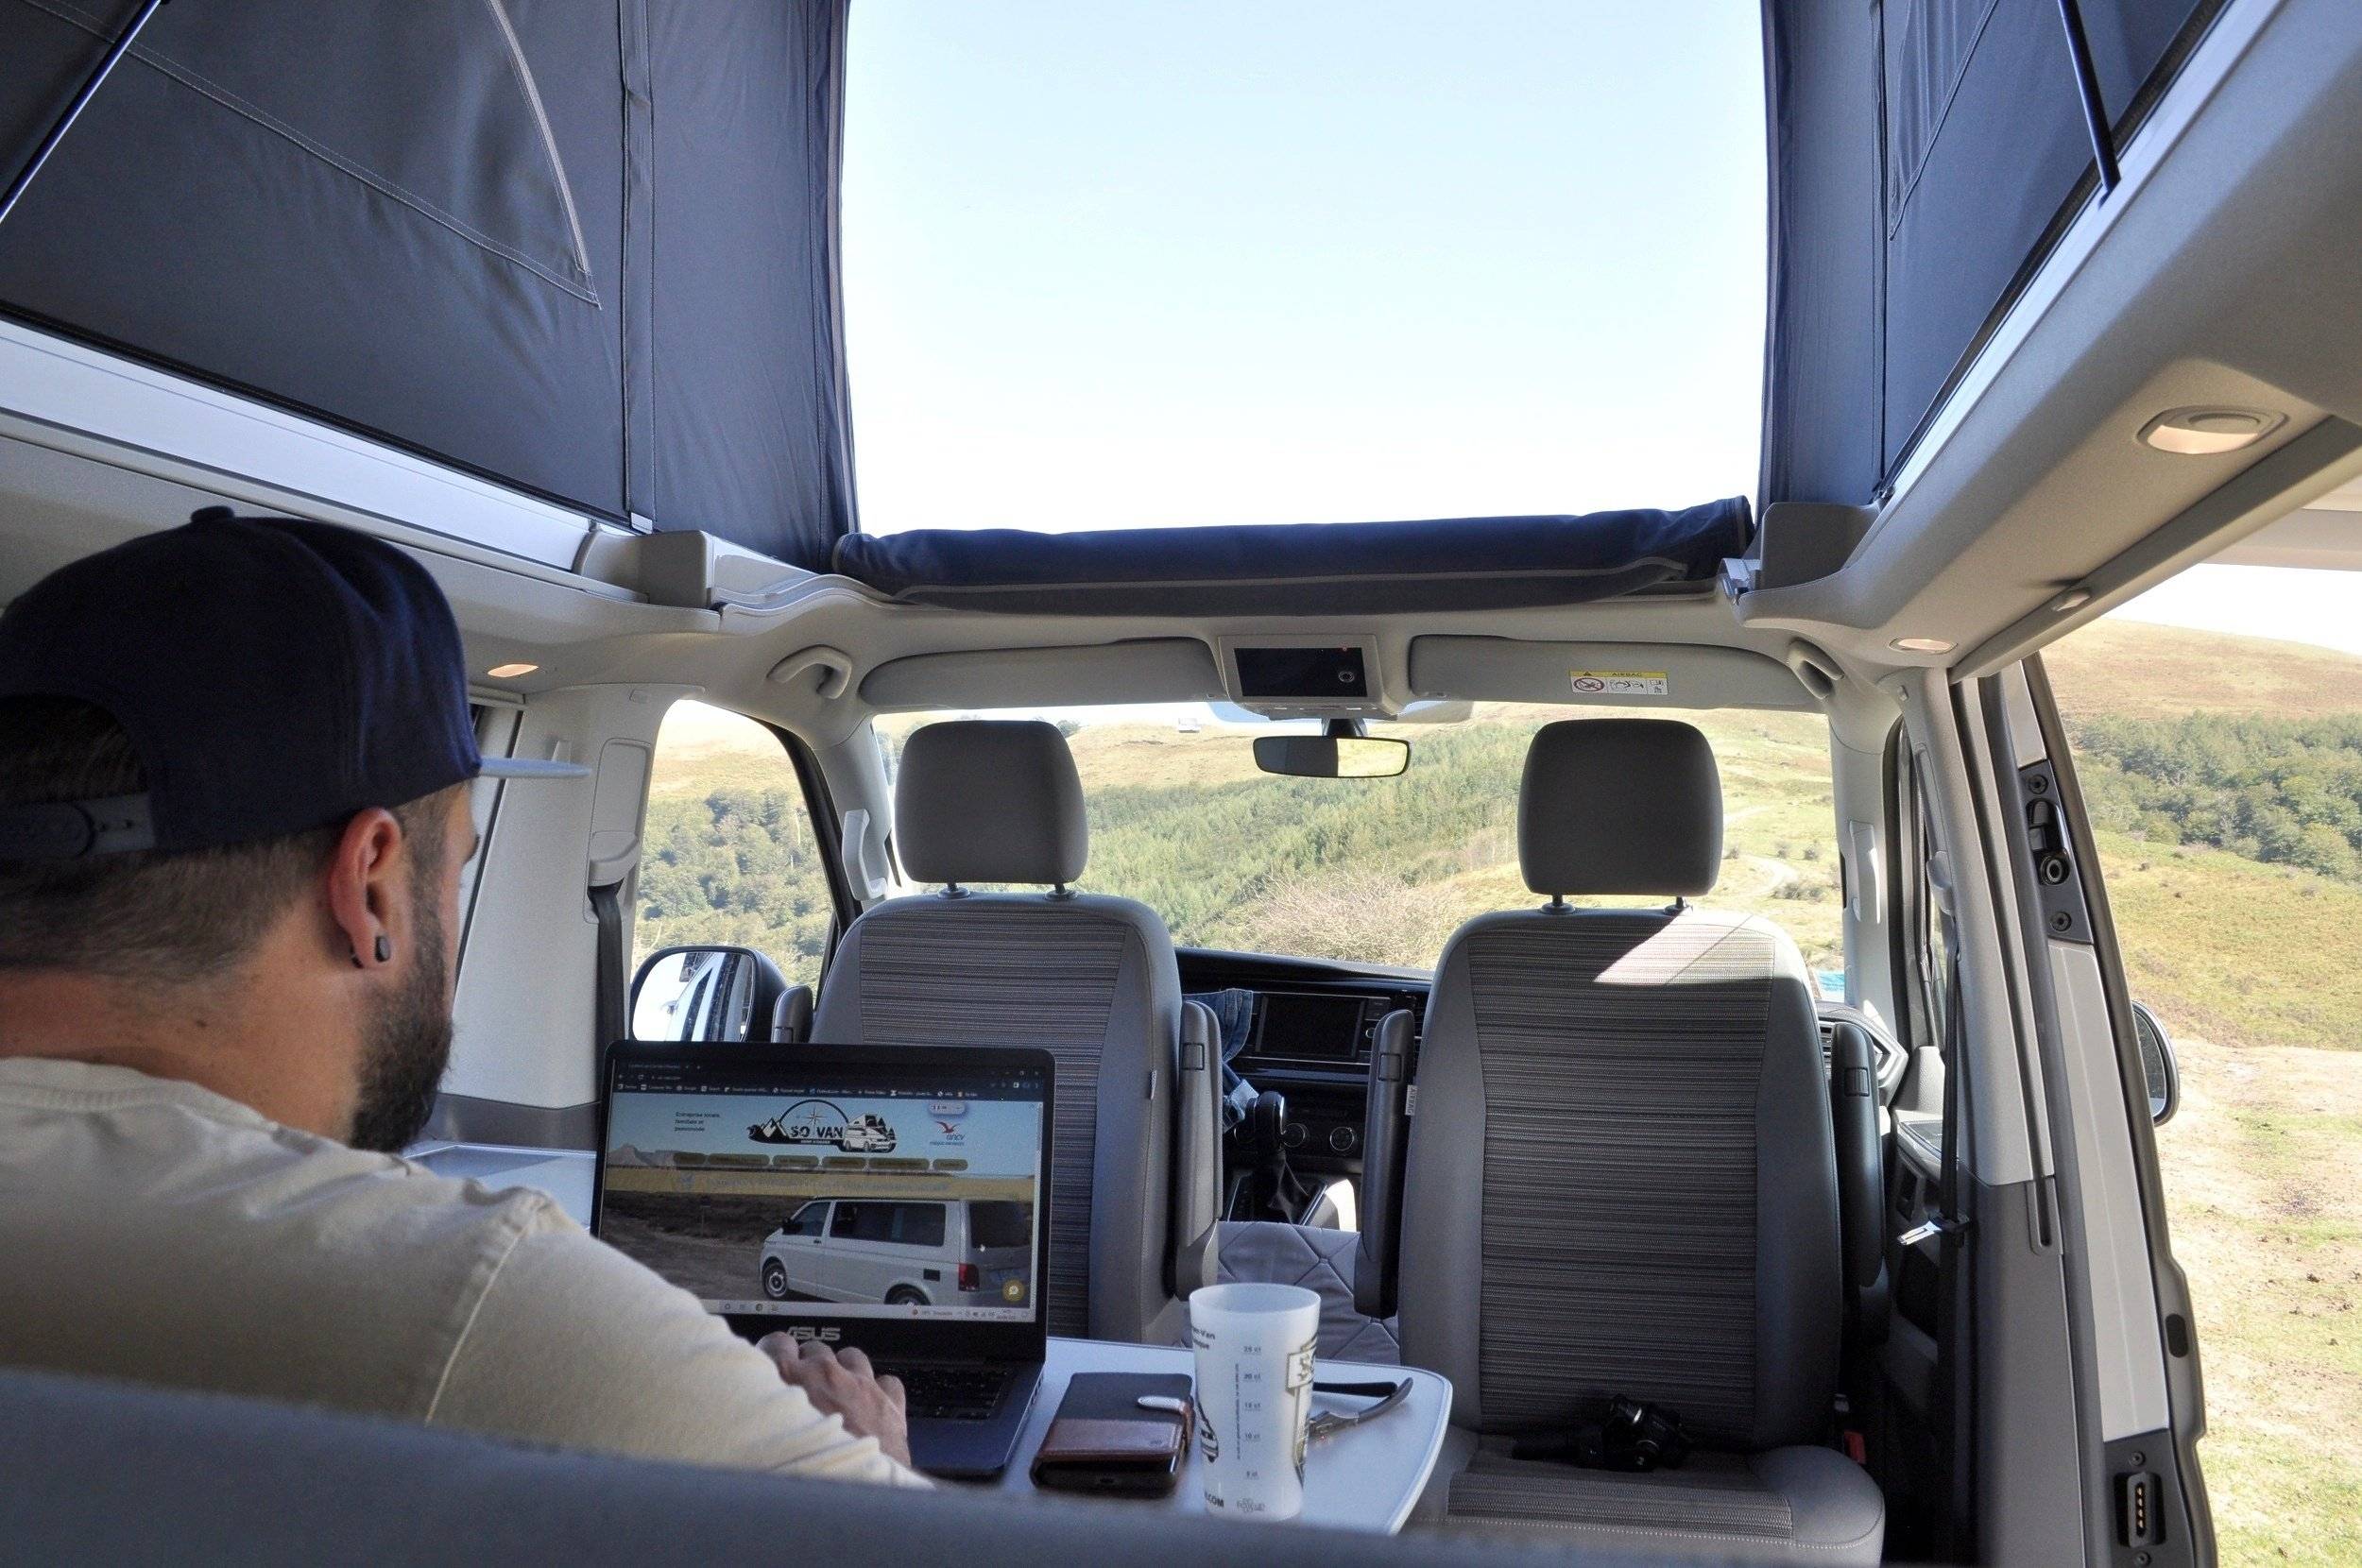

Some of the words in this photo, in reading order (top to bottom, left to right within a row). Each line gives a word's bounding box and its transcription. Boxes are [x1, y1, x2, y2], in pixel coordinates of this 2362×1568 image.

[1407, 1087, 1417, 1115] AIRBAG
[791, 1125, 811, 1137] SO
[816, 1125, 844, 1139] VAN
[786, 1326, 841, 1341] ASUS
